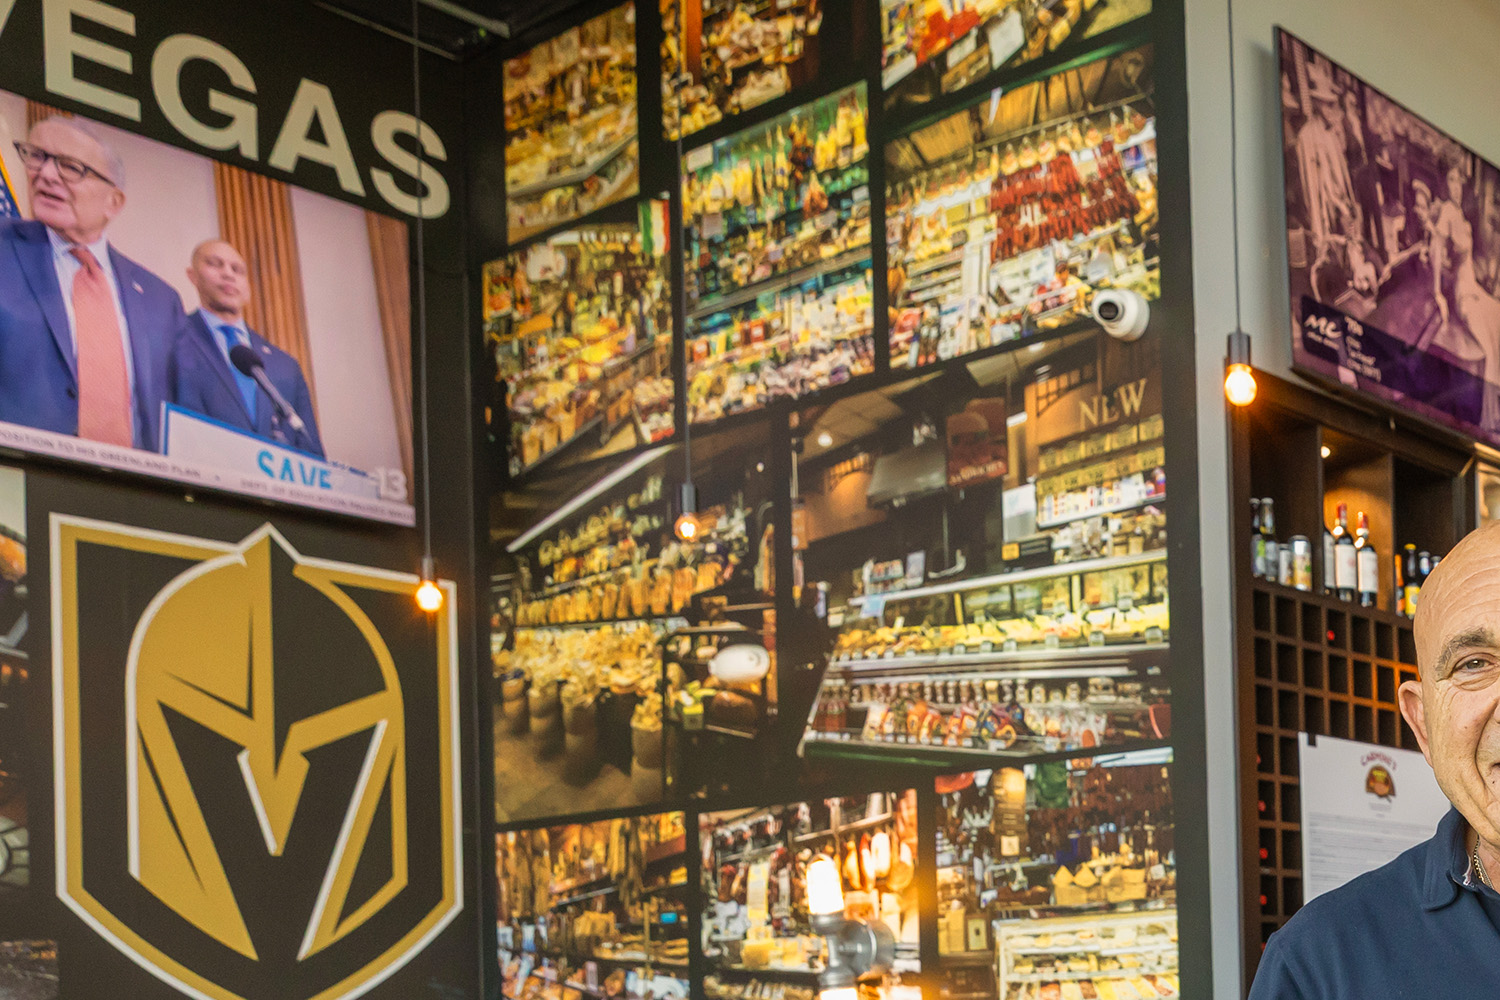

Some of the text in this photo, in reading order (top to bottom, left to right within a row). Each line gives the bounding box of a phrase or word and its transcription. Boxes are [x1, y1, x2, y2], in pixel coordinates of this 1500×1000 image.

[0, 0, 451, 219] EGAS
[0, 429, 54, 449] OSITION
[257, 449, 332, 489] SAVE
